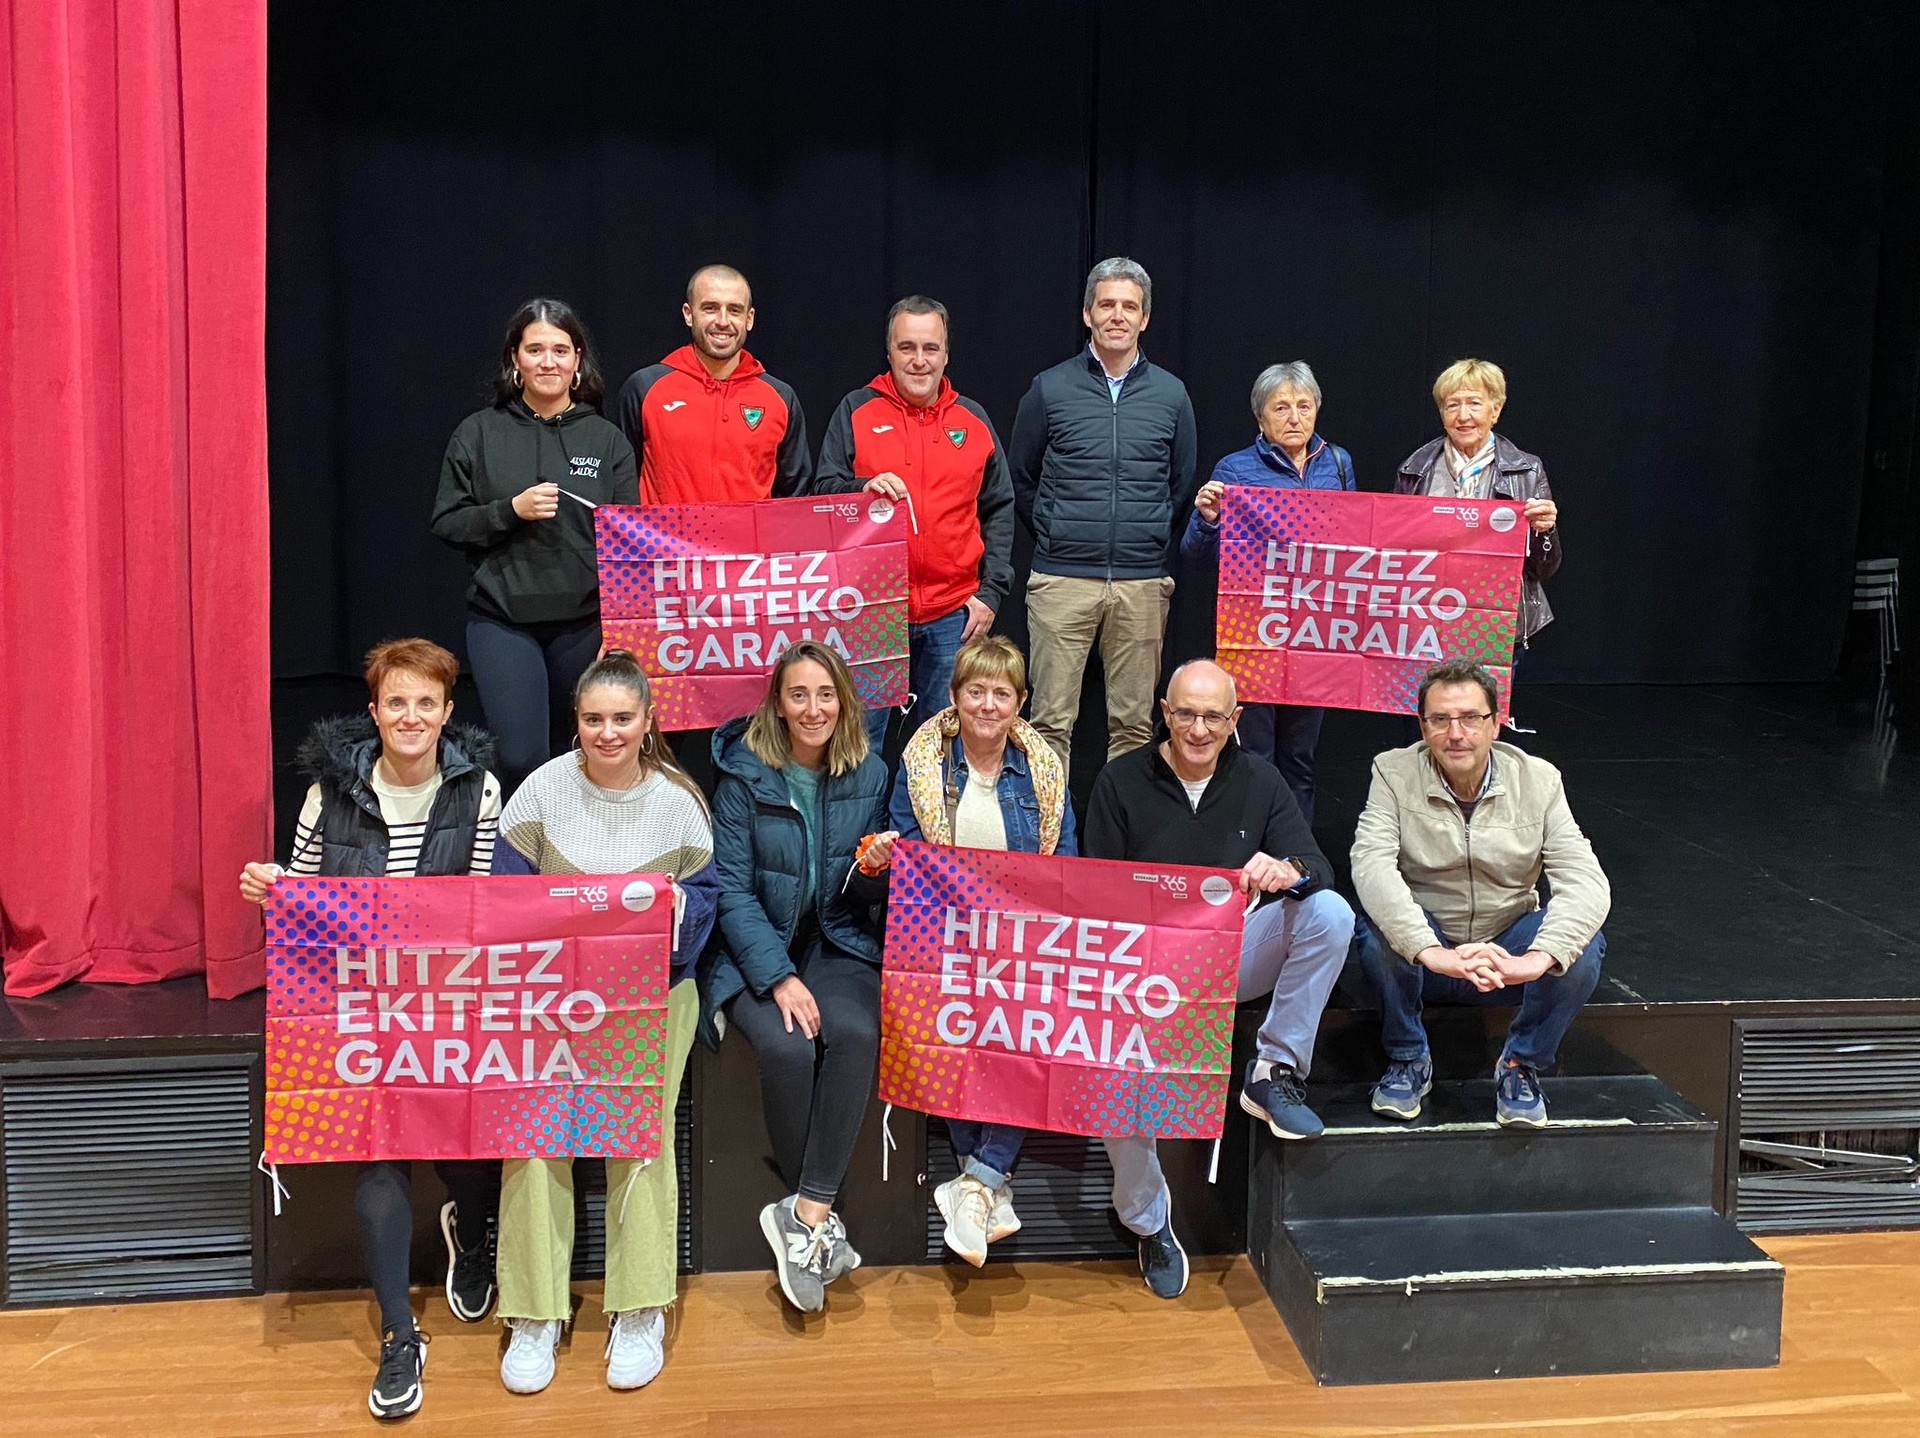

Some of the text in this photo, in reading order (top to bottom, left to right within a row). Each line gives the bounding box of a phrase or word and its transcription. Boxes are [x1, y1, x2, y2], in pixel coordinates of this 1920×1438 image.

[835, 503, 858, 517] 365
[1456, 507, 1479, 521] 365
[653, 550, 829, 592] HITZEZ
[1265, 538, 1438, 582] HITZEZ
[655, 586, 864, 632] EKITEKO
[1261, 575, 1467, 621] EKITEKO
[1257, 612, 1443, 661] GARAIA
[578, 885, 608, 903] 365
[1160, 875, 1187, 892] 365
[943, 906, 1146, 966] HITZEZ
[335, 940, 563, 986] HITZEZ
[940, 954, 1180, 1018] EKITEKO
[336, 990, 606, 1033] EKITEKO
[936, 1002, 1156, 1069] GARAIA
[334, 1038, 584, 1085] GARAIA
